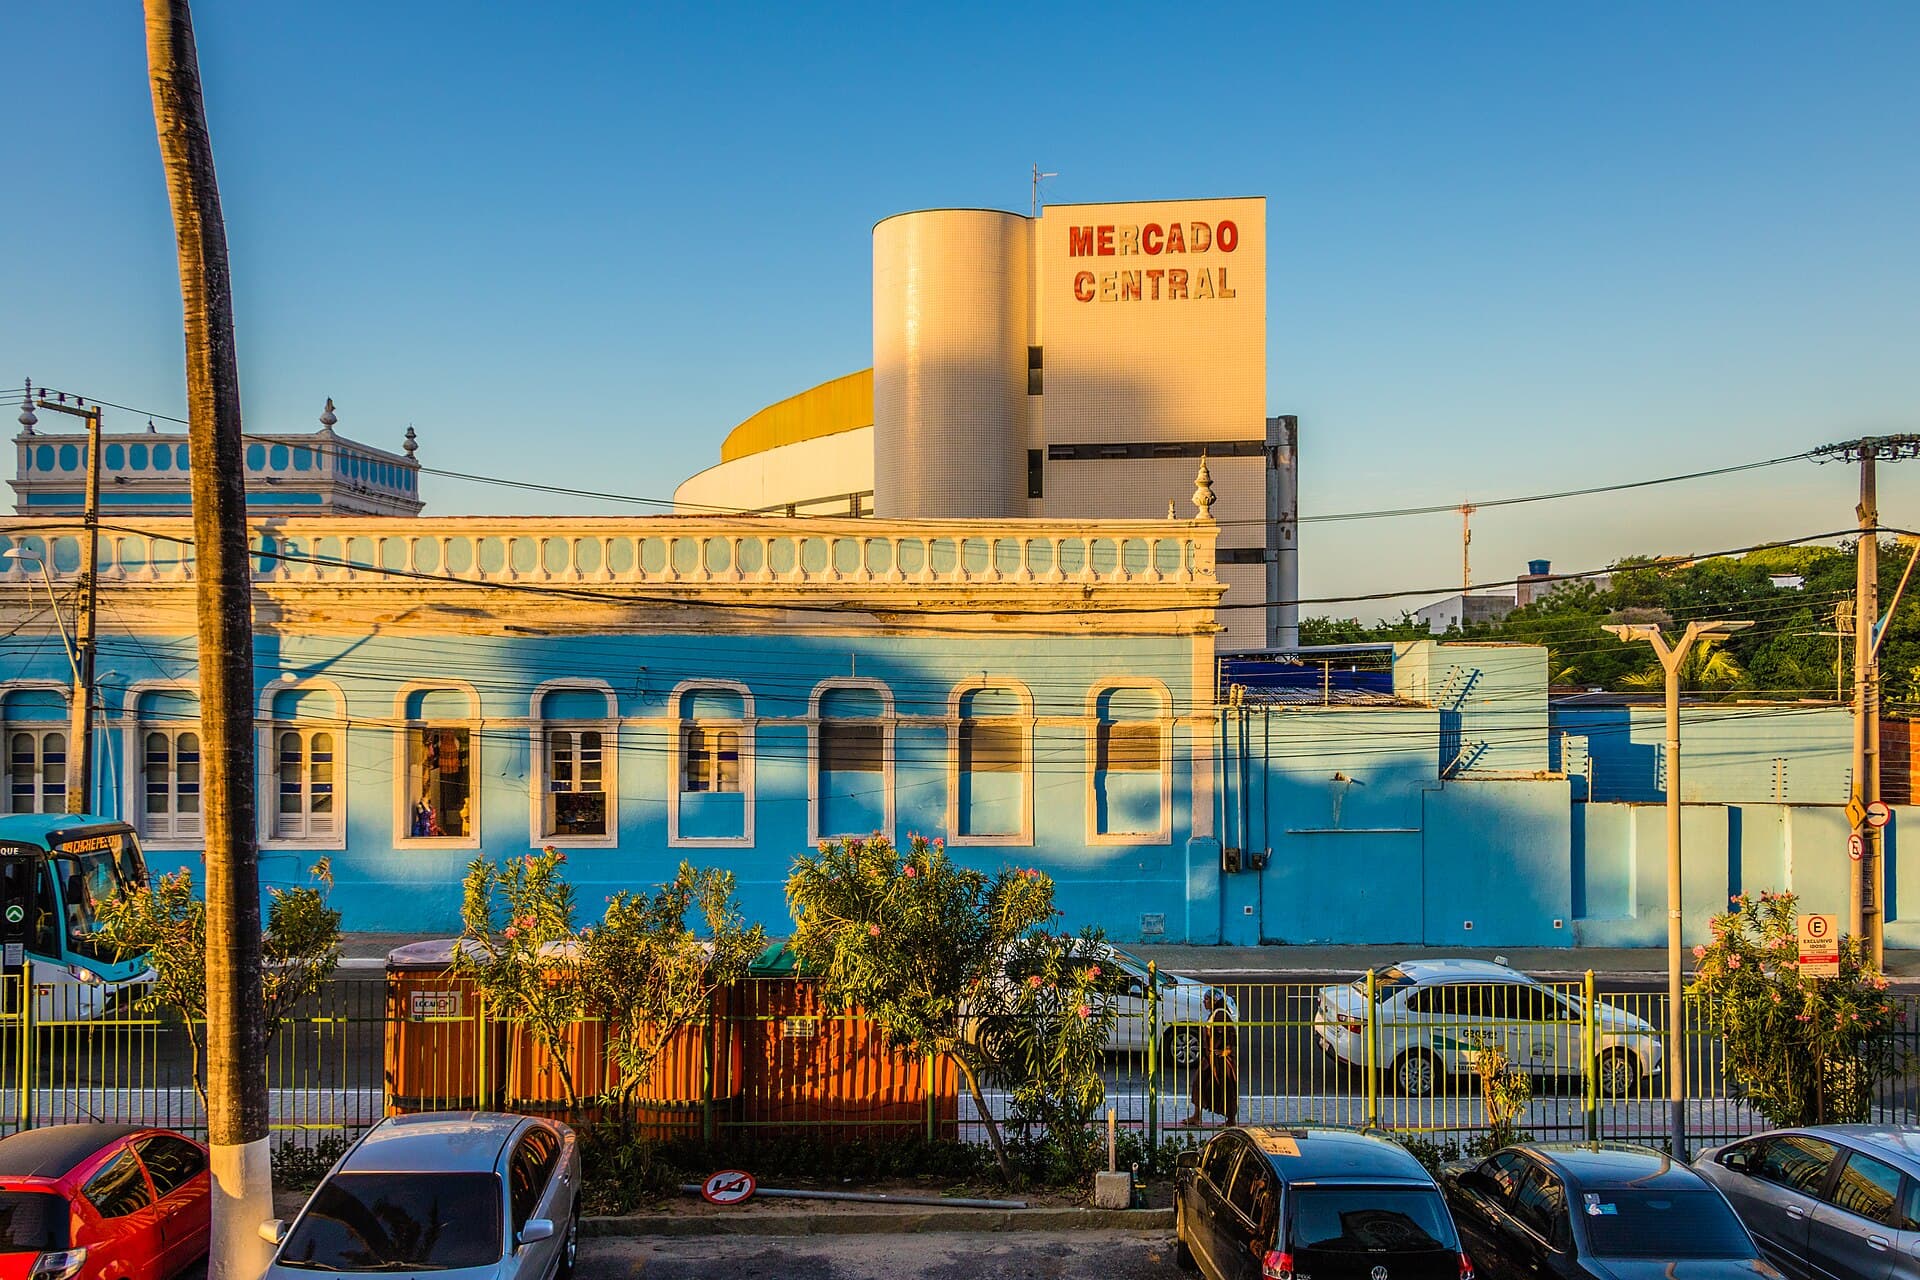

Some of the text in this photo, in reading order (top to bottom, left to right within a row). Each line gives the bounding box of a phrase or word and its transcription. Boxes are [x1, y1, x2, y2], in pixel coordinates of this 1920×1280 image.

[1069, 219, 1239, 257] MERCADO
[1073, 267, 1236, 303] CENTRAL
[1813, 921, 1822, 933] E
